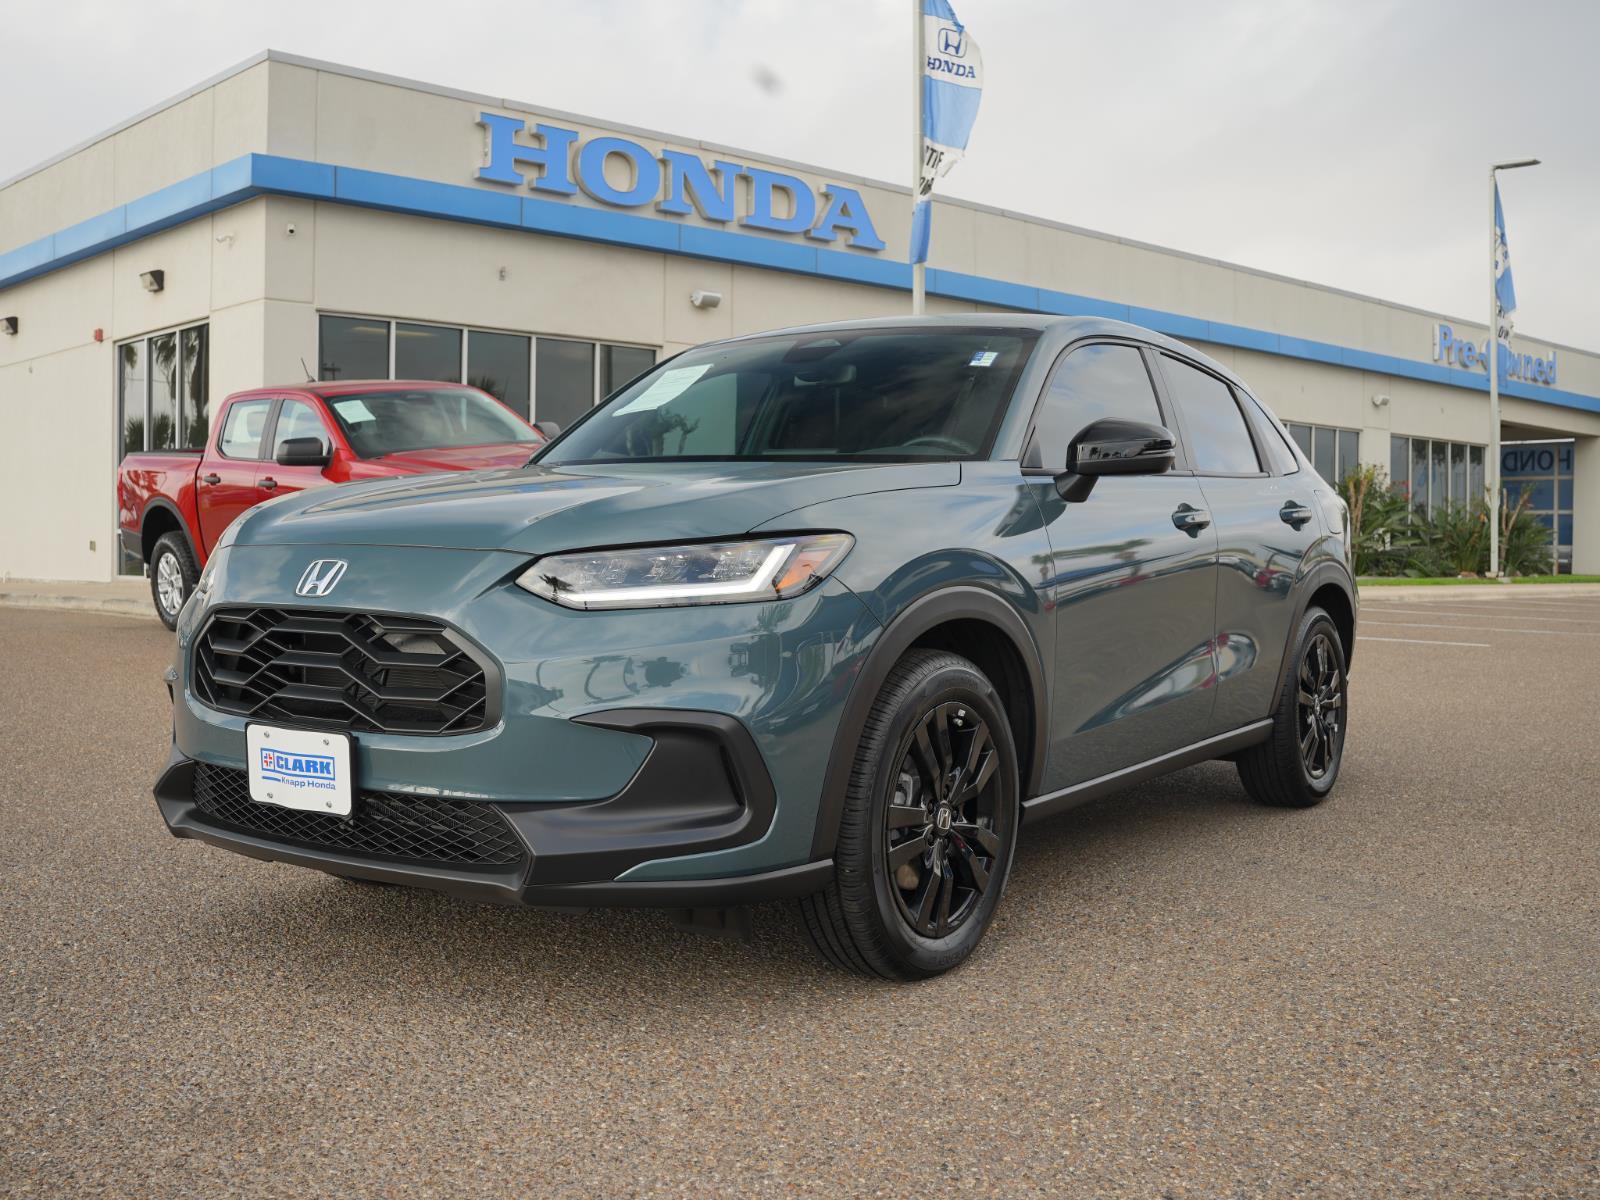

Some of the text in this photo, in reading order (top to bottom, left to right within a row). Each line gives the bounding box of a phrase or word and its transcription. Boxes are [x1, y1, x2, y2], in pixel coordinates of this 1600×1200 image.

[474, 111, 886, 252] HONDA
[276, 755, 331, 775] CLARK
[281, 776, 336, 790] Knapp Honda
